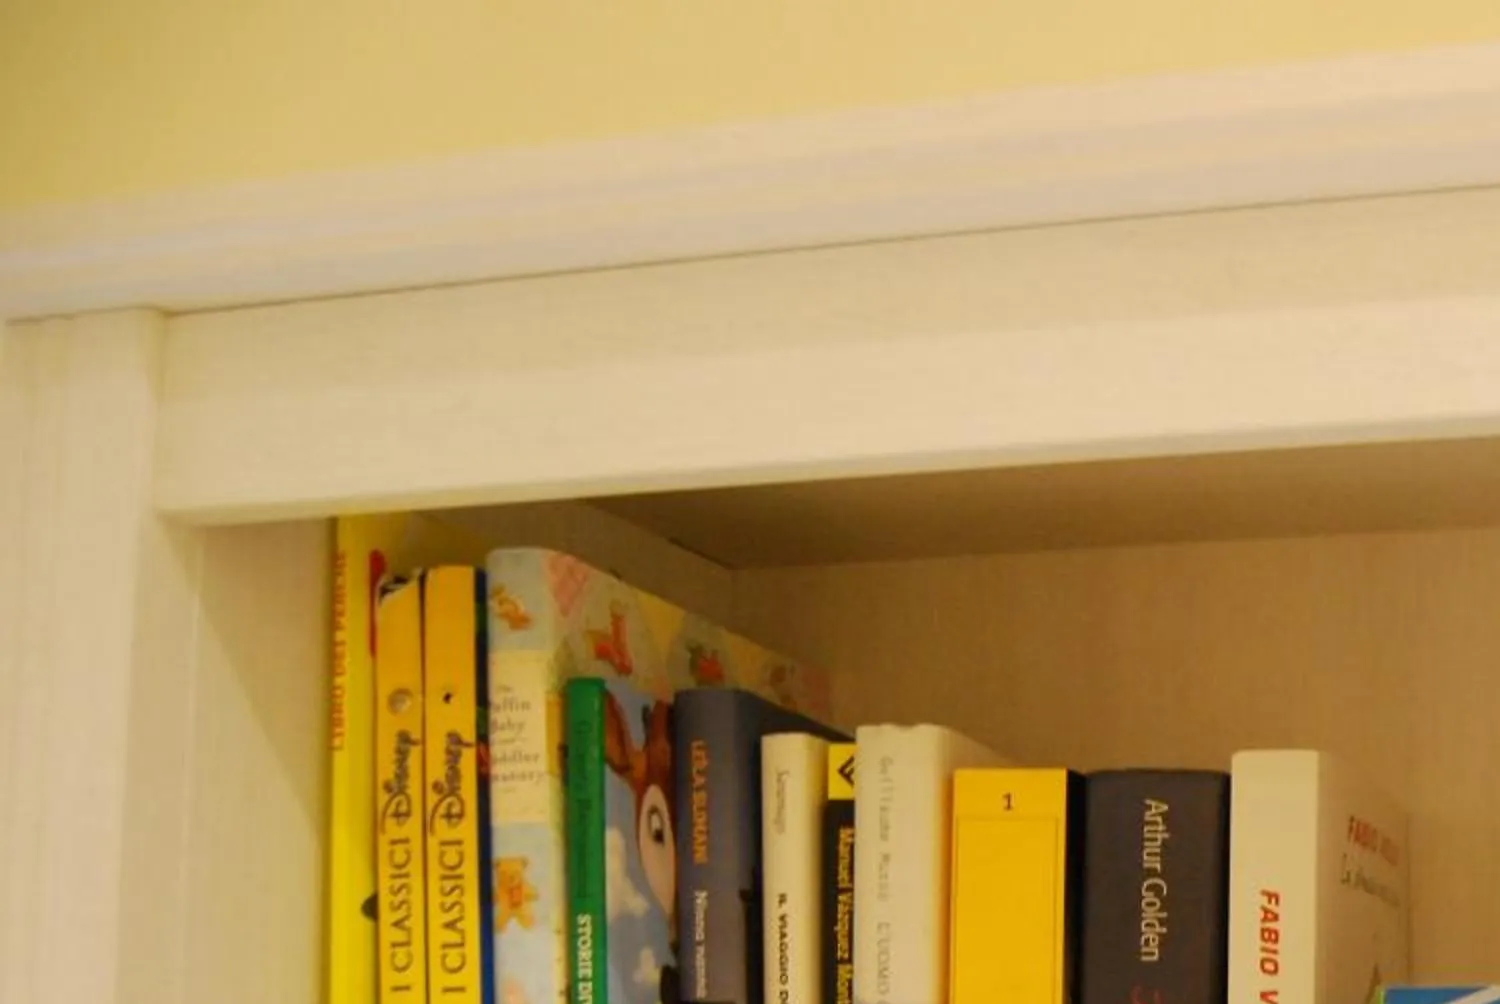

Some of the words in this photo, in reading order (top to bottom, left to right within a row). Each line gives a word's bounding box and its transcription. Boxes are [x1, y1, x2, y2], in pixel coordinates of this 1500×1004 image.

[380, 730, 423, 836] Disney
[429, 730, 476, 836] Disney
[1002, 793, 1014, 812] 1
[837, 827, 854, 888] Manuel
[1141, 798, 1170, 874] Arthur
[388, 837, 414, 974] CLASSICI
[438, 838, 467, 975] CLASSICI
[778, 892, 787, 908] IL
[1139, 876, 1168, 962] Golden
[1259, 889, 1280, 976] FABIO
[577, 914, 592, 979] STORIE
[778, 915, 789, 985] VIAGGIO
